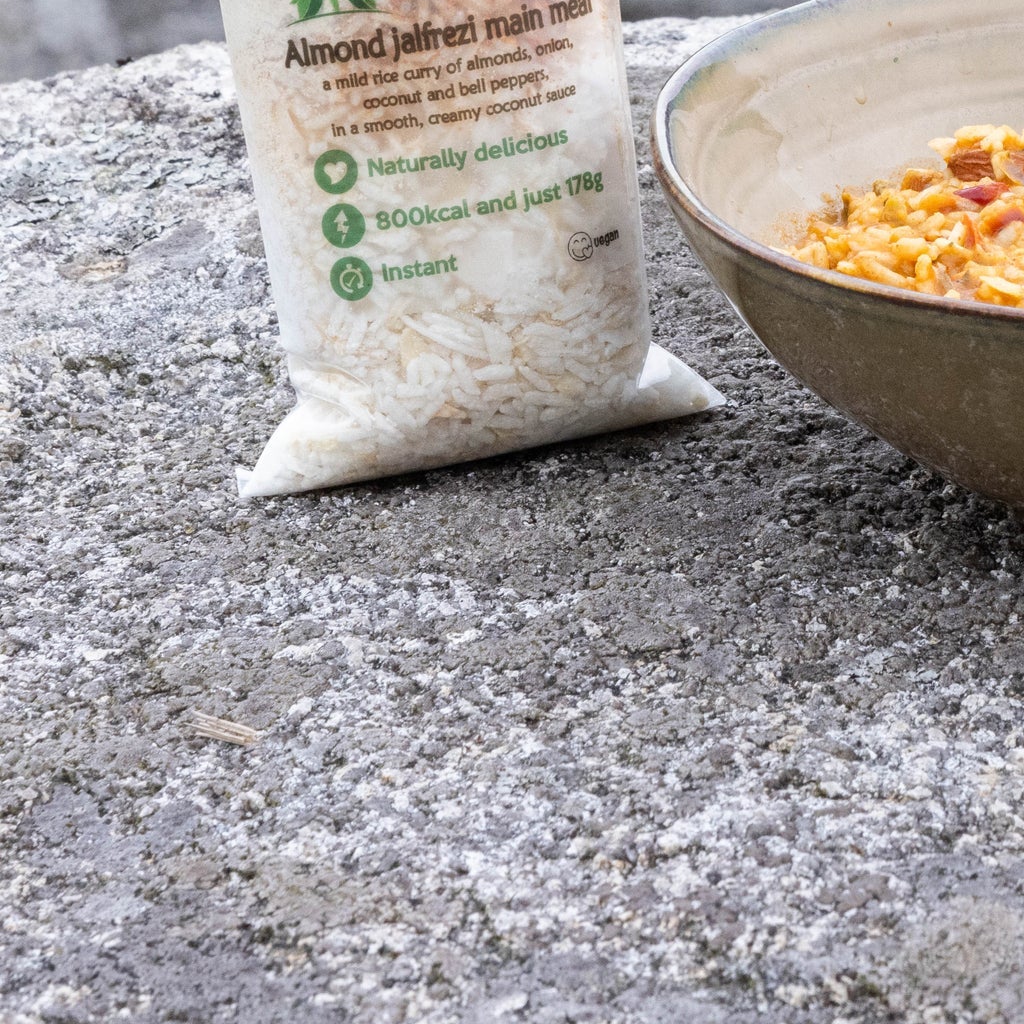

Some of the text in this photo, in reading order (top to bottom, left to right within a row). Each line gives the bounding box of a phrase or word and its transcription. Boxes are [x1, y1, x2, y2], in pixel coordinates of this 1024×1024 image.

[285, 29, 386, 68] Almond
[392, 15, 475, 62] jalfrezi
[484, 5, 544, 40] main
[322, 36, 574, 91] a mild rice curry of almonds, onion,
[363, 68, 549, 109] coconut and bell peppers,
[331, 84, 577, 137] in a smooth, creamy coconut sauce
[366, 129, 569, 177] Naturally delicious
[375, 172, 604, 231] 800kcal and just 178g
[594, 228, 620, 248] vegan
[382, 254, 458, 282] Instant
